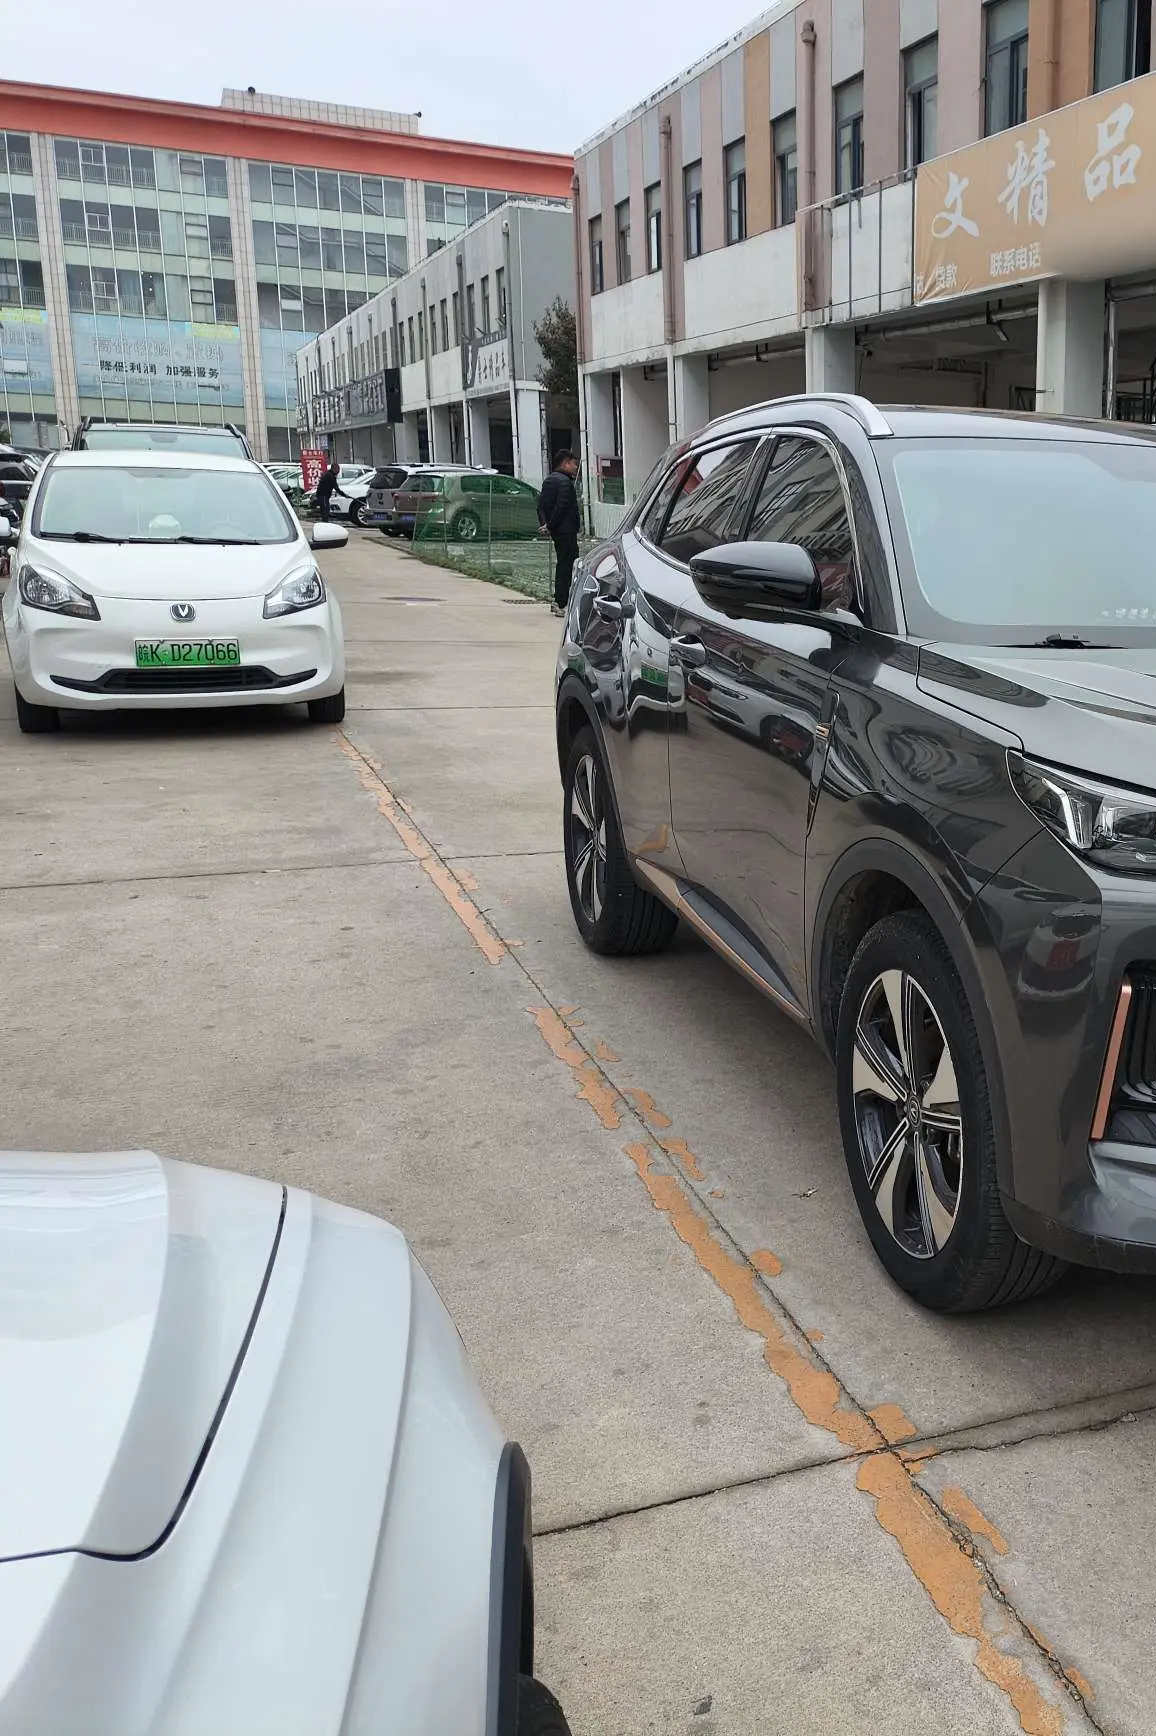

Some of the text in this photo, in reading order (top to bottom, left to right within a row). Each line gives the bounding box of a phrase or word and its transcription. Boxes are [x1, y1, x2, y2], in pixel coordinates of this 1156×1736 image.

[989, 242, 1042, 277] 联系电话
[100, 360, 219, 380] 降低利润 加强服务
